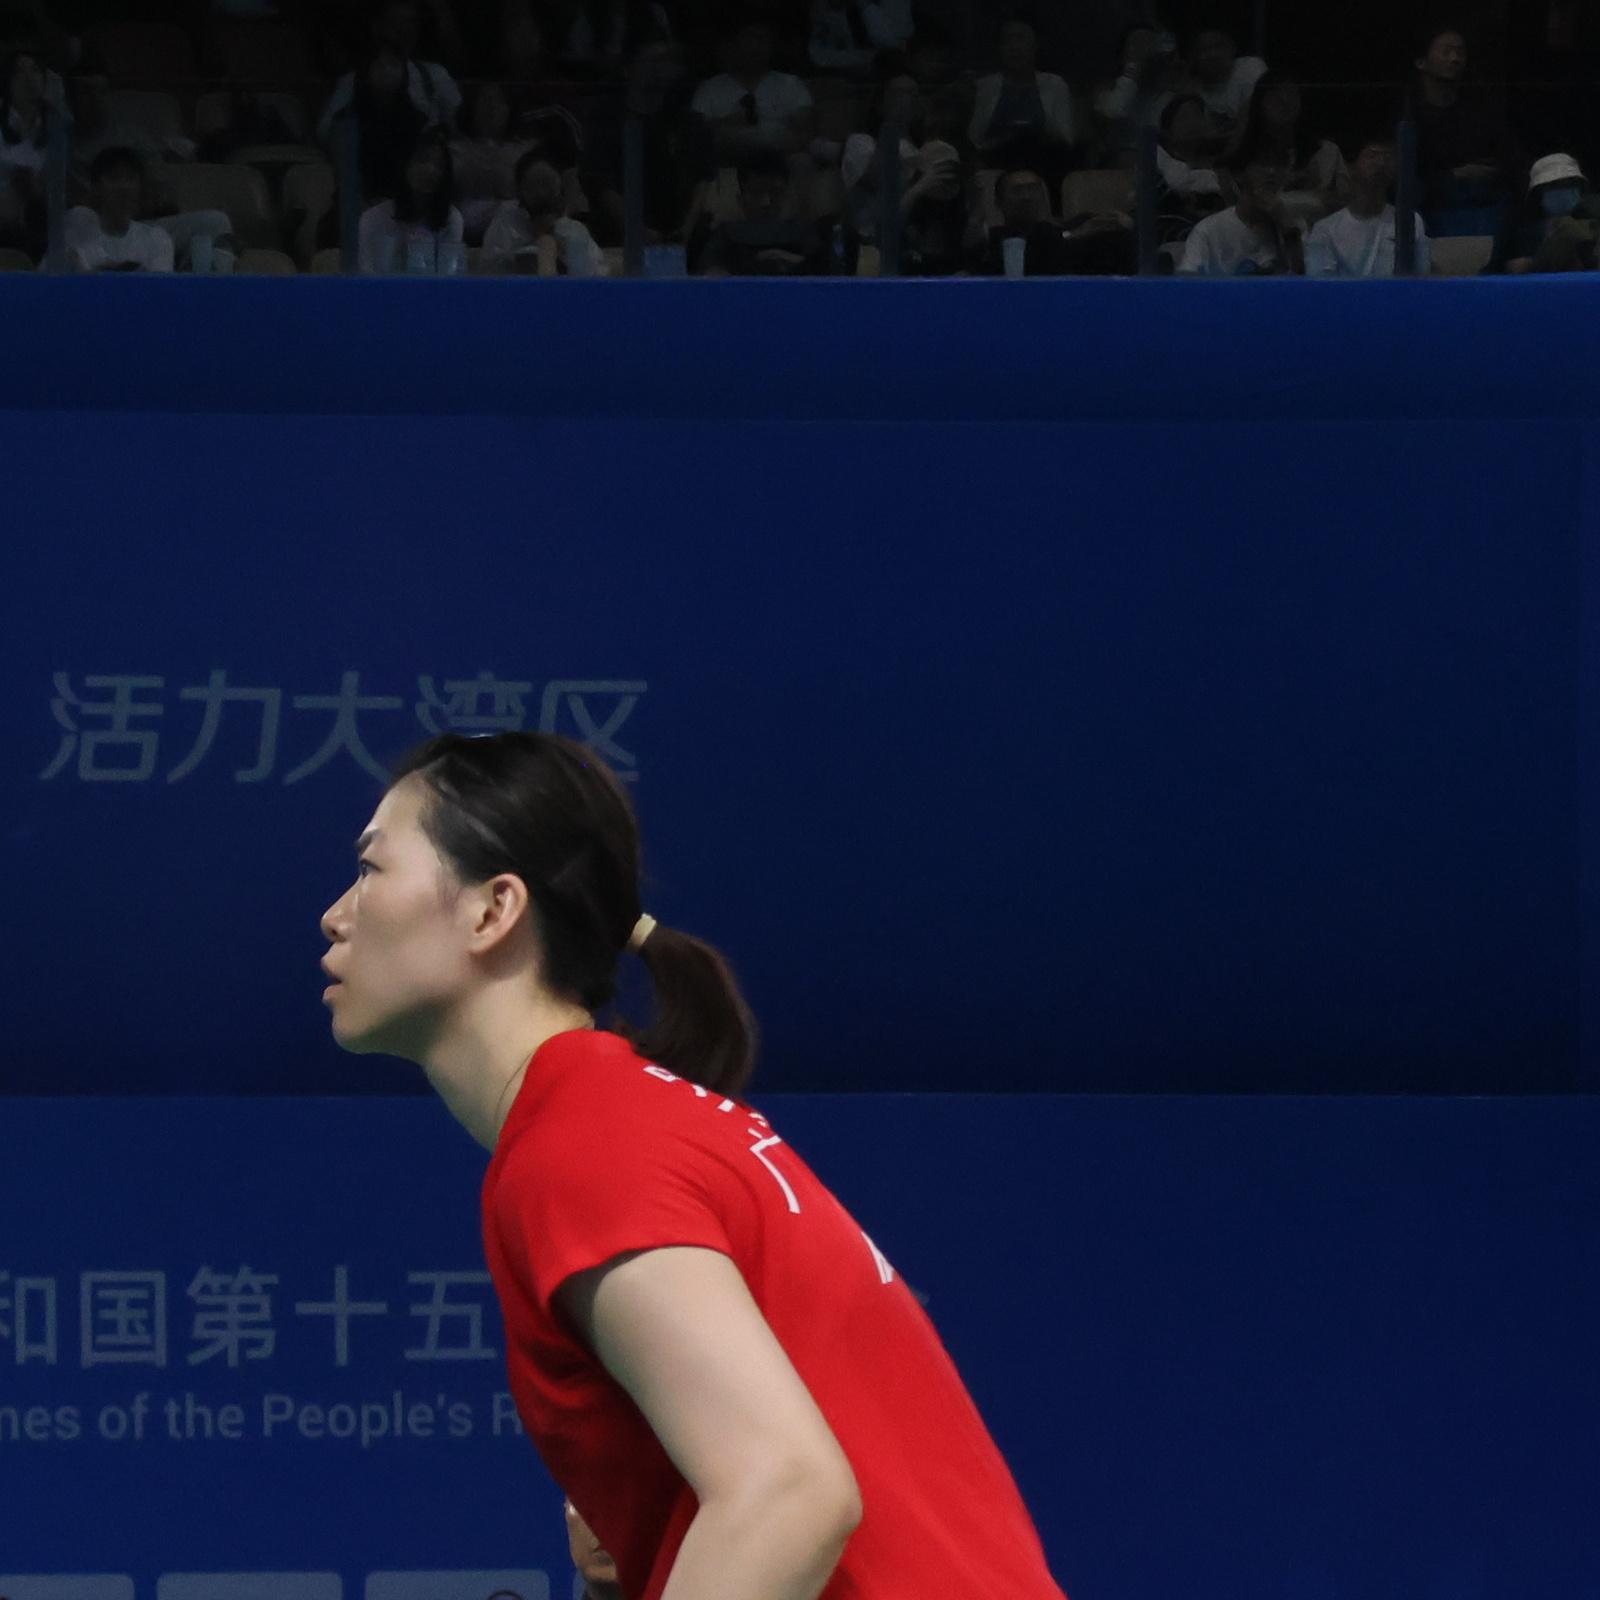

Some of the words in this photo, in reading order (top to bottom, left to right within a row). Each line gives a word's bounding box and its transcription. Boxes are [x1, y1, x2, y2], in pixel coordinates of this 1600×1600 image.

[101, 1393, 150, 1440] of
[164, 1392, 246, 1440] the
[263, 1390, 472, 1448] People's
